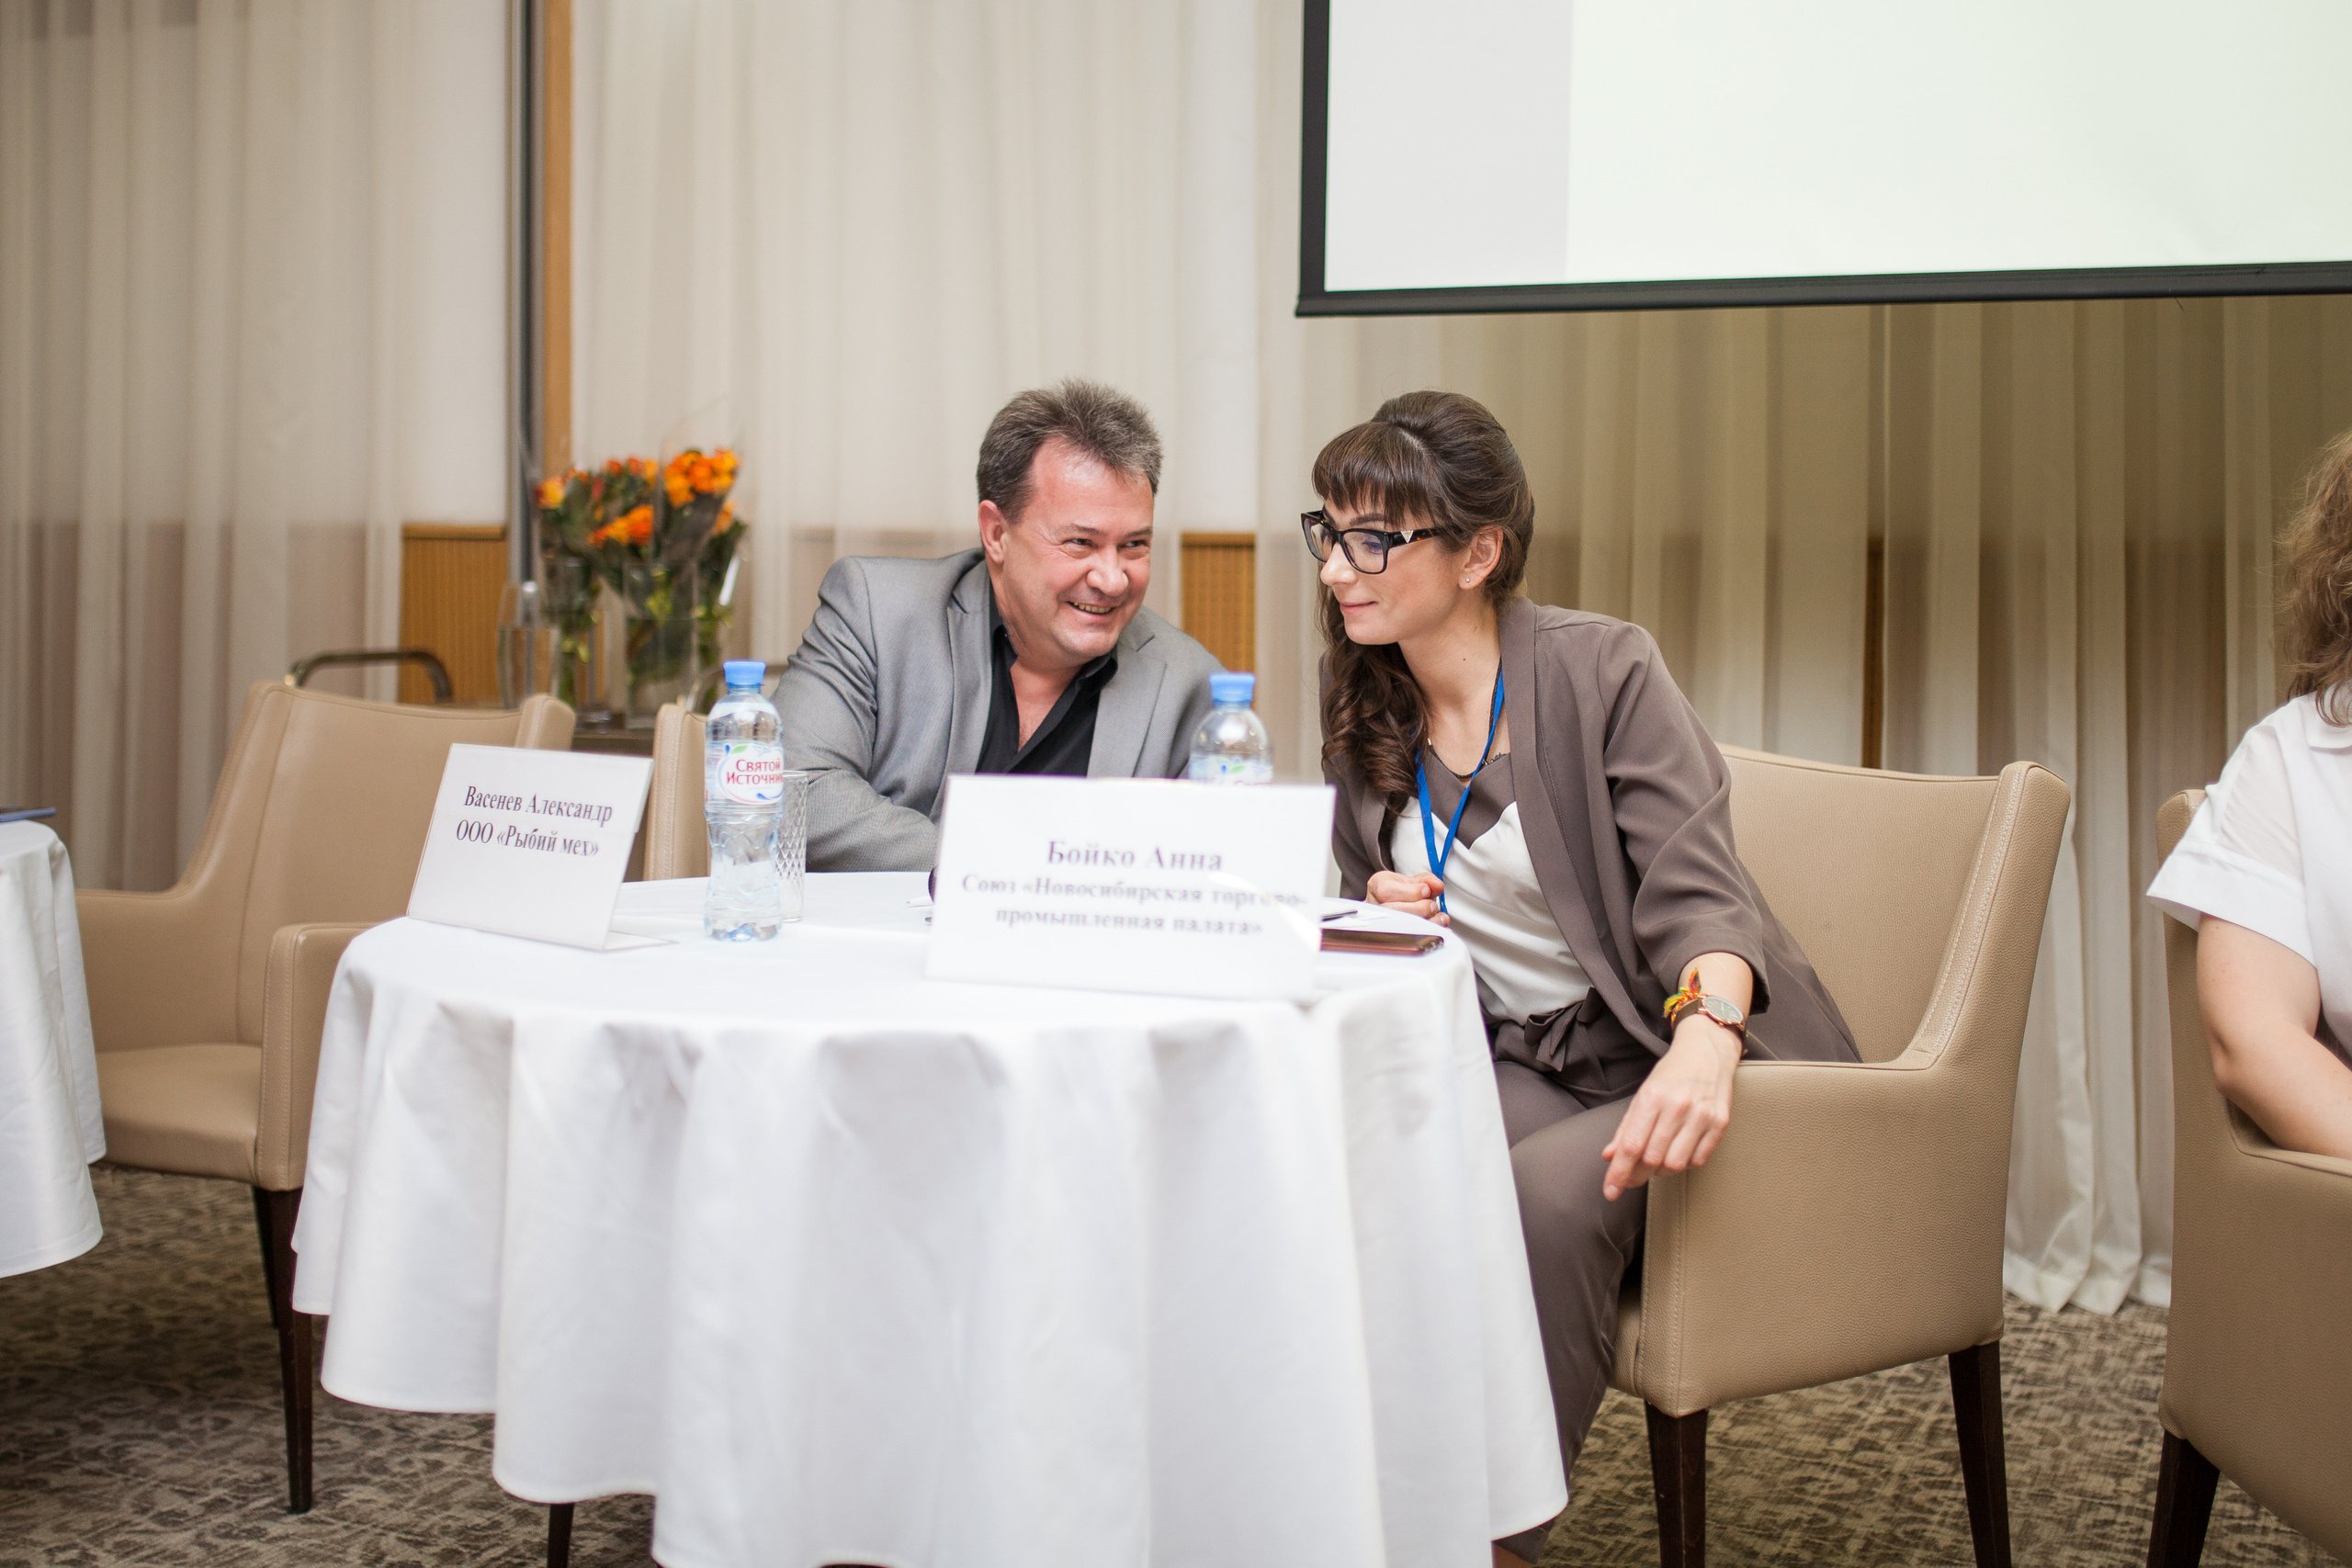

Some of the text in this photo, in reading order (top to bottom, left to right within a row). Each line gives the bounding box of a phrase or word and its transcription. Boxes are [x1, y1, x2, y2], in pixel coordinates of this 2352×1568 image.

[463, 785, 614, 828] Васенев Александр
[456, 819, 599, 856] ООО «Рыбий мех»
[1047, 840, 1223, 872] Бойко Анна
[962, 874, 1017, 893] Союз
[1022, 875, 1202, 906] «Новосибирская
[995, 907, 1263, 936] промышленная палата»
